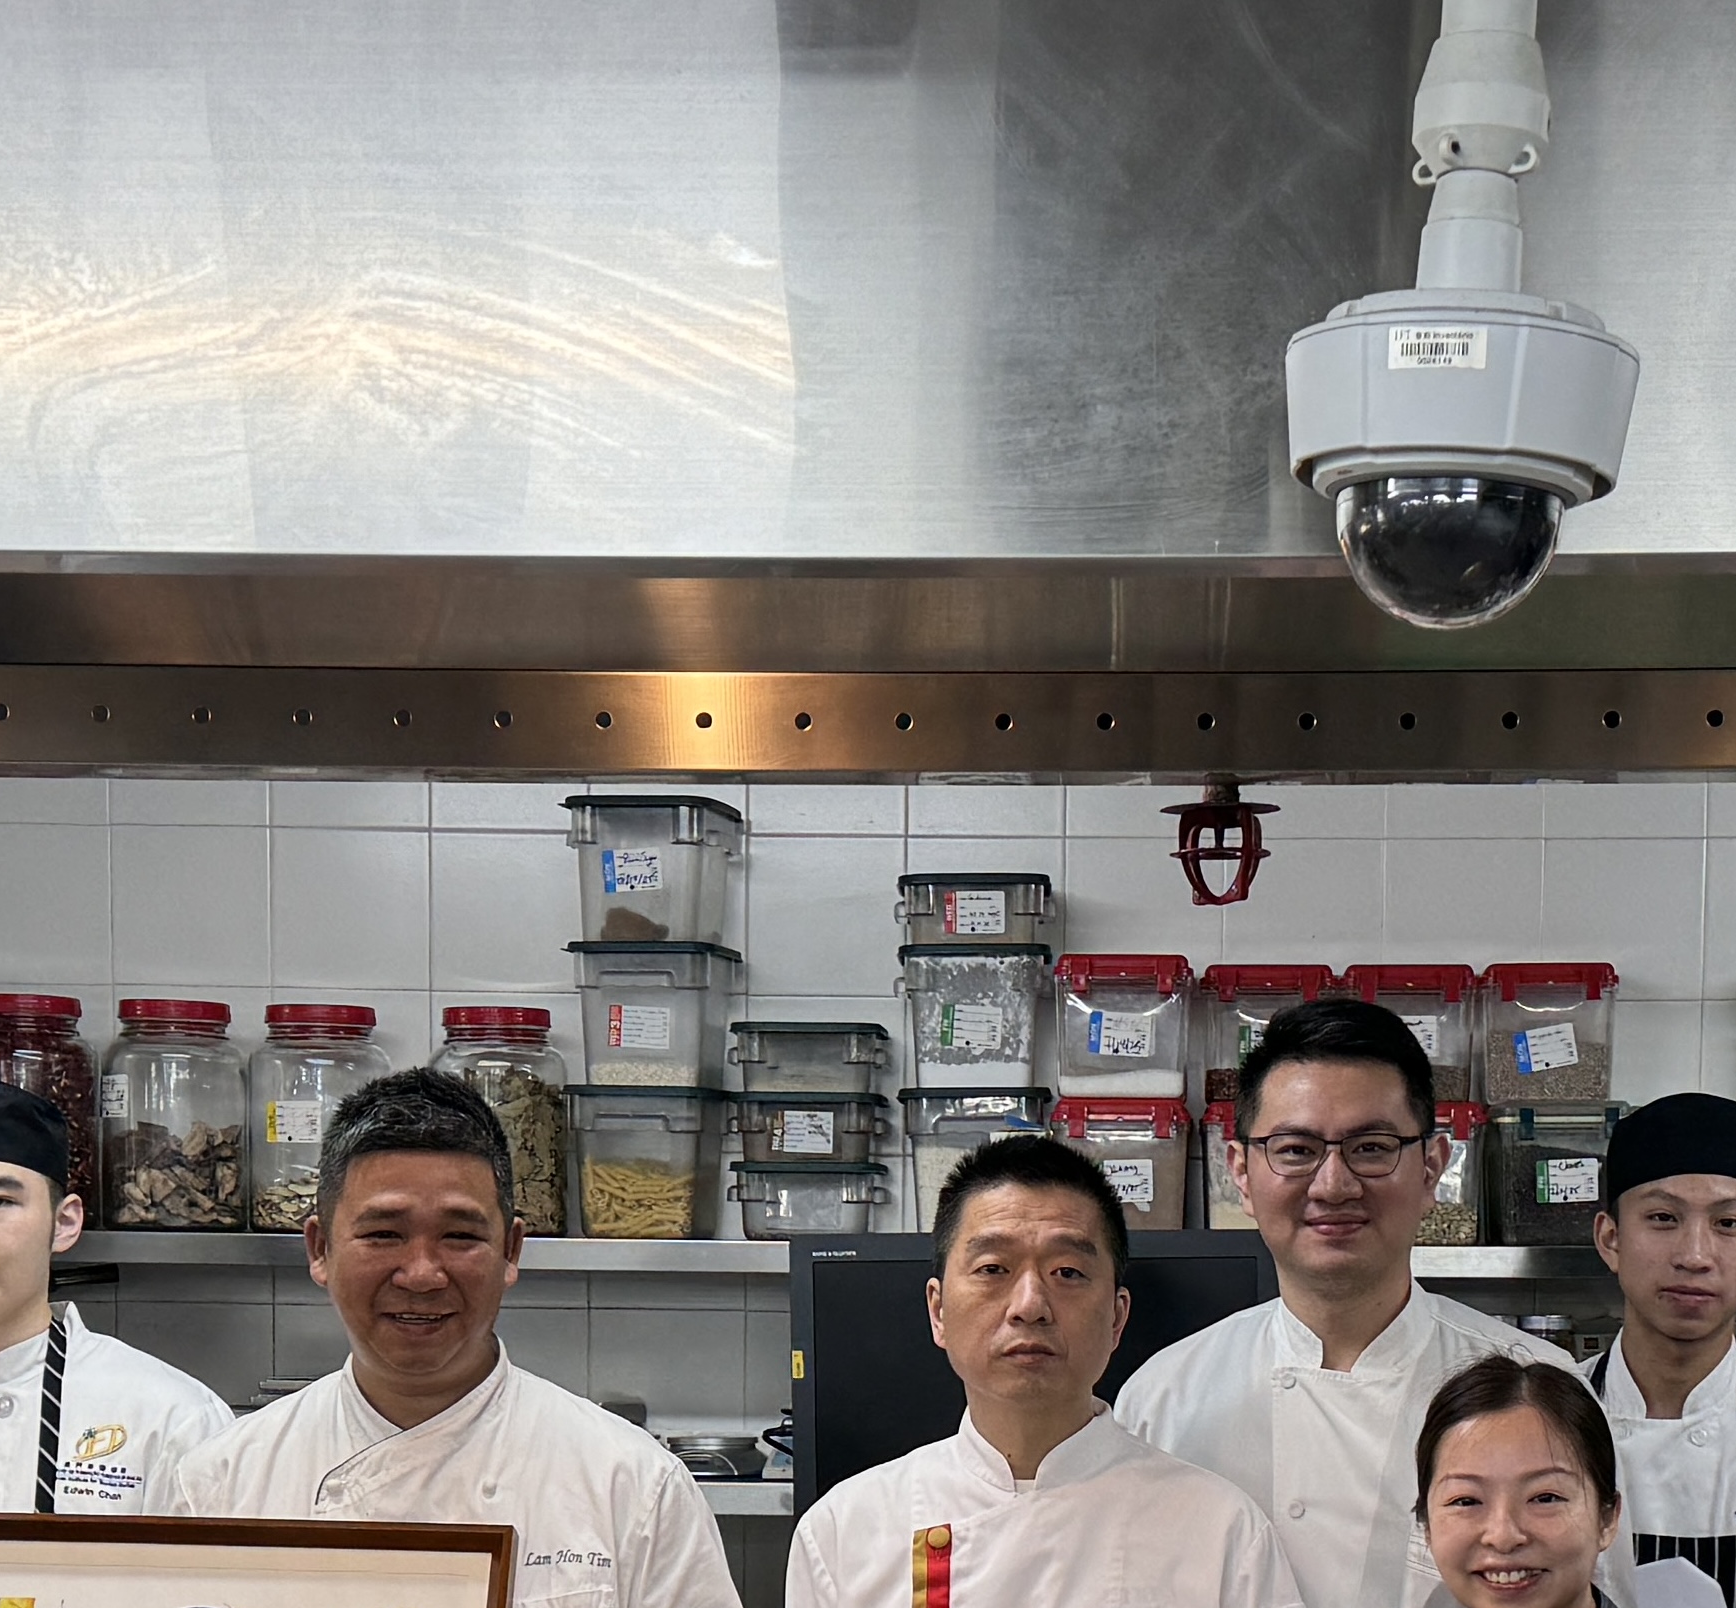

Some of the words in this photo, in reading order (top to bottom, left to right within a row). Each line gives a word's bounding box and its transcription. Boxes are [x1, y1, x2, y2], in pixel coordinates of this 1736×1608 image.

[524, 1552, 552, 1566] Lam
[555, 1548, 583, 1564] Hon
[586, 1552, 612, 1568] Tim
